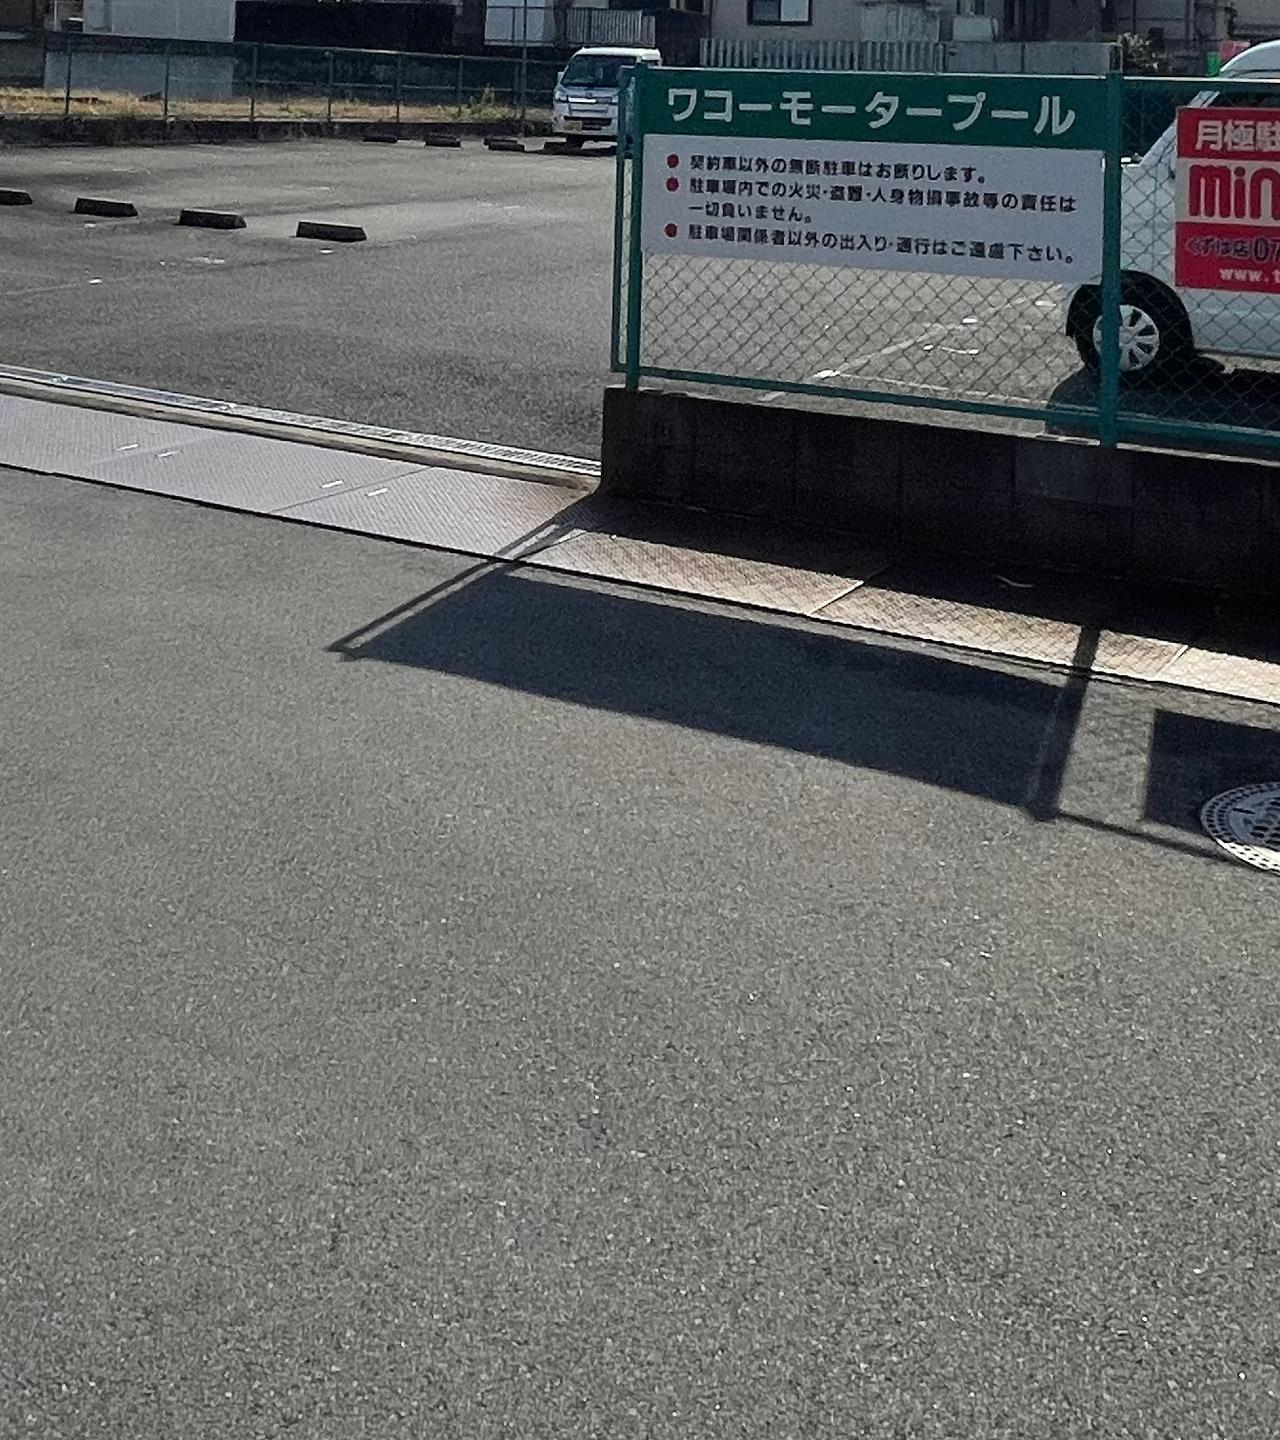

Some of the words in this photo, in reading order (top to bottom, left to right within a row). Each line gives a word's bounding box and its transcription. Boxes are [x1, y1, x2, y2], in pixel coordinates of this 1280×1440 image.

[666, 87, 1077, 137] ワコーモータープール
[689, 154, 986, 184] 契約車以外の無断駐車はお断りします。
[688, 200, 813, 224] 一切負いません。
